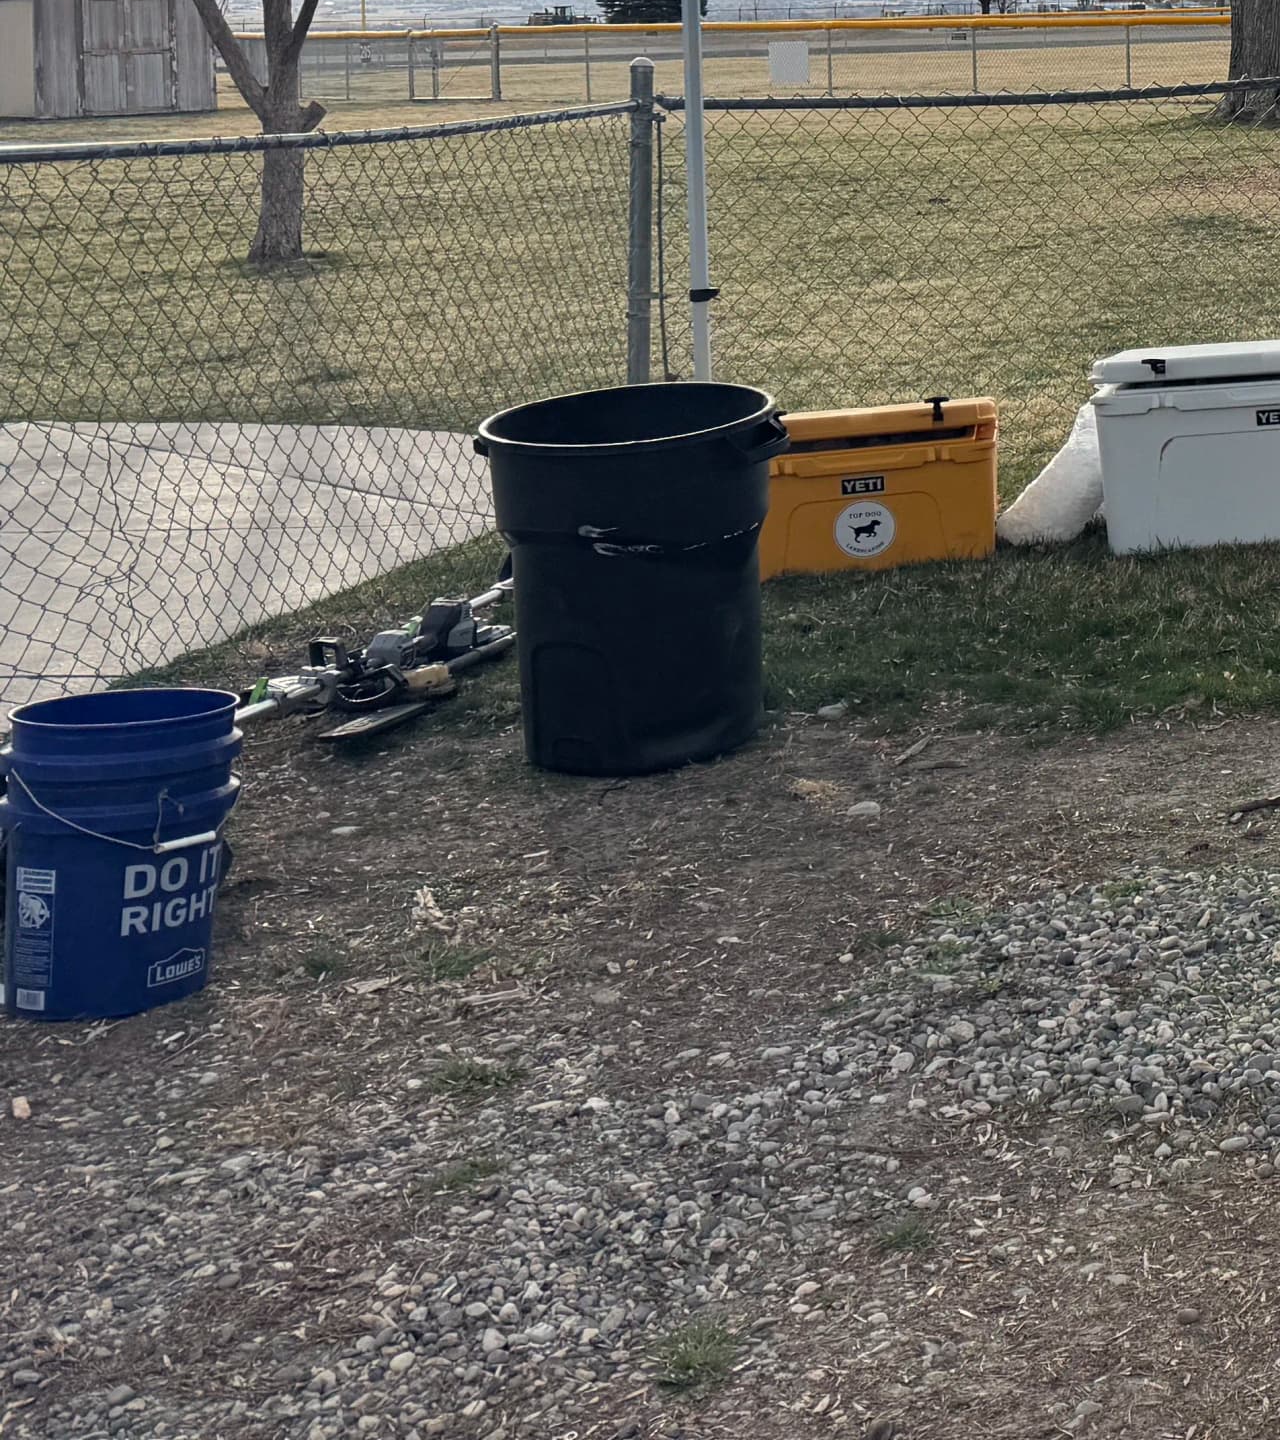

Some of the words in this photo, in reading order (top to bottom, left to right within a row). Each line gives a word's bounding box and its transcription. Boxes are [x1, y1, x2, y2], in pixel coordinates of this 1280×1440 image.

[843, 478, 883, 493] YETI
[123, 856, 189, 900] DO
[199, 843, 221, 883] IT
[120, 884, 217, 937] RIGHT
[155, 955, 202, 982] LOWE'S
